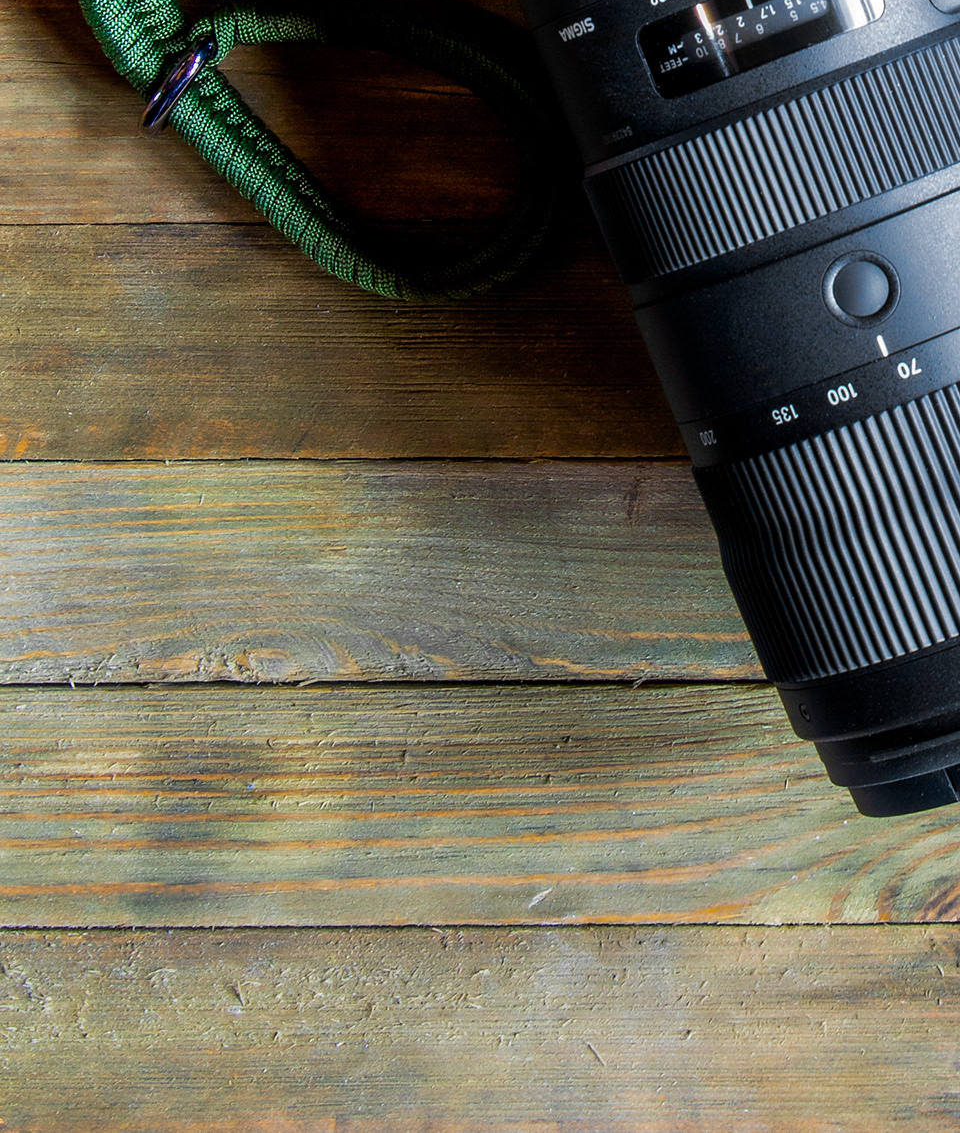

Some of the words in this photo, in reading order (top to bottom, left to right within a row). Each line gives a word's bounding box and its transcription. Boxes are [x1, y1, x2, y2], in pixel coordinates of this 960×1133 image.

[759, 3, 777, 20] 1.7
[789, 9, 798, 22] 5
[735, 16, 745, 28] 2
[558, 16, 595, 42] SIGMA
[755, 23, 764, 35] 6
[694, 32, 704, 44] 3
[717, 38, 727, 50] 8
[734, 32, 742, 44] 7
[695, 45, 710, 58] 10
[897, 358, 922, 380] 70
[827, 382, 858, 406] 100
[771, 405, 799, 425] 135
[699, 429, 717, 446] 200
